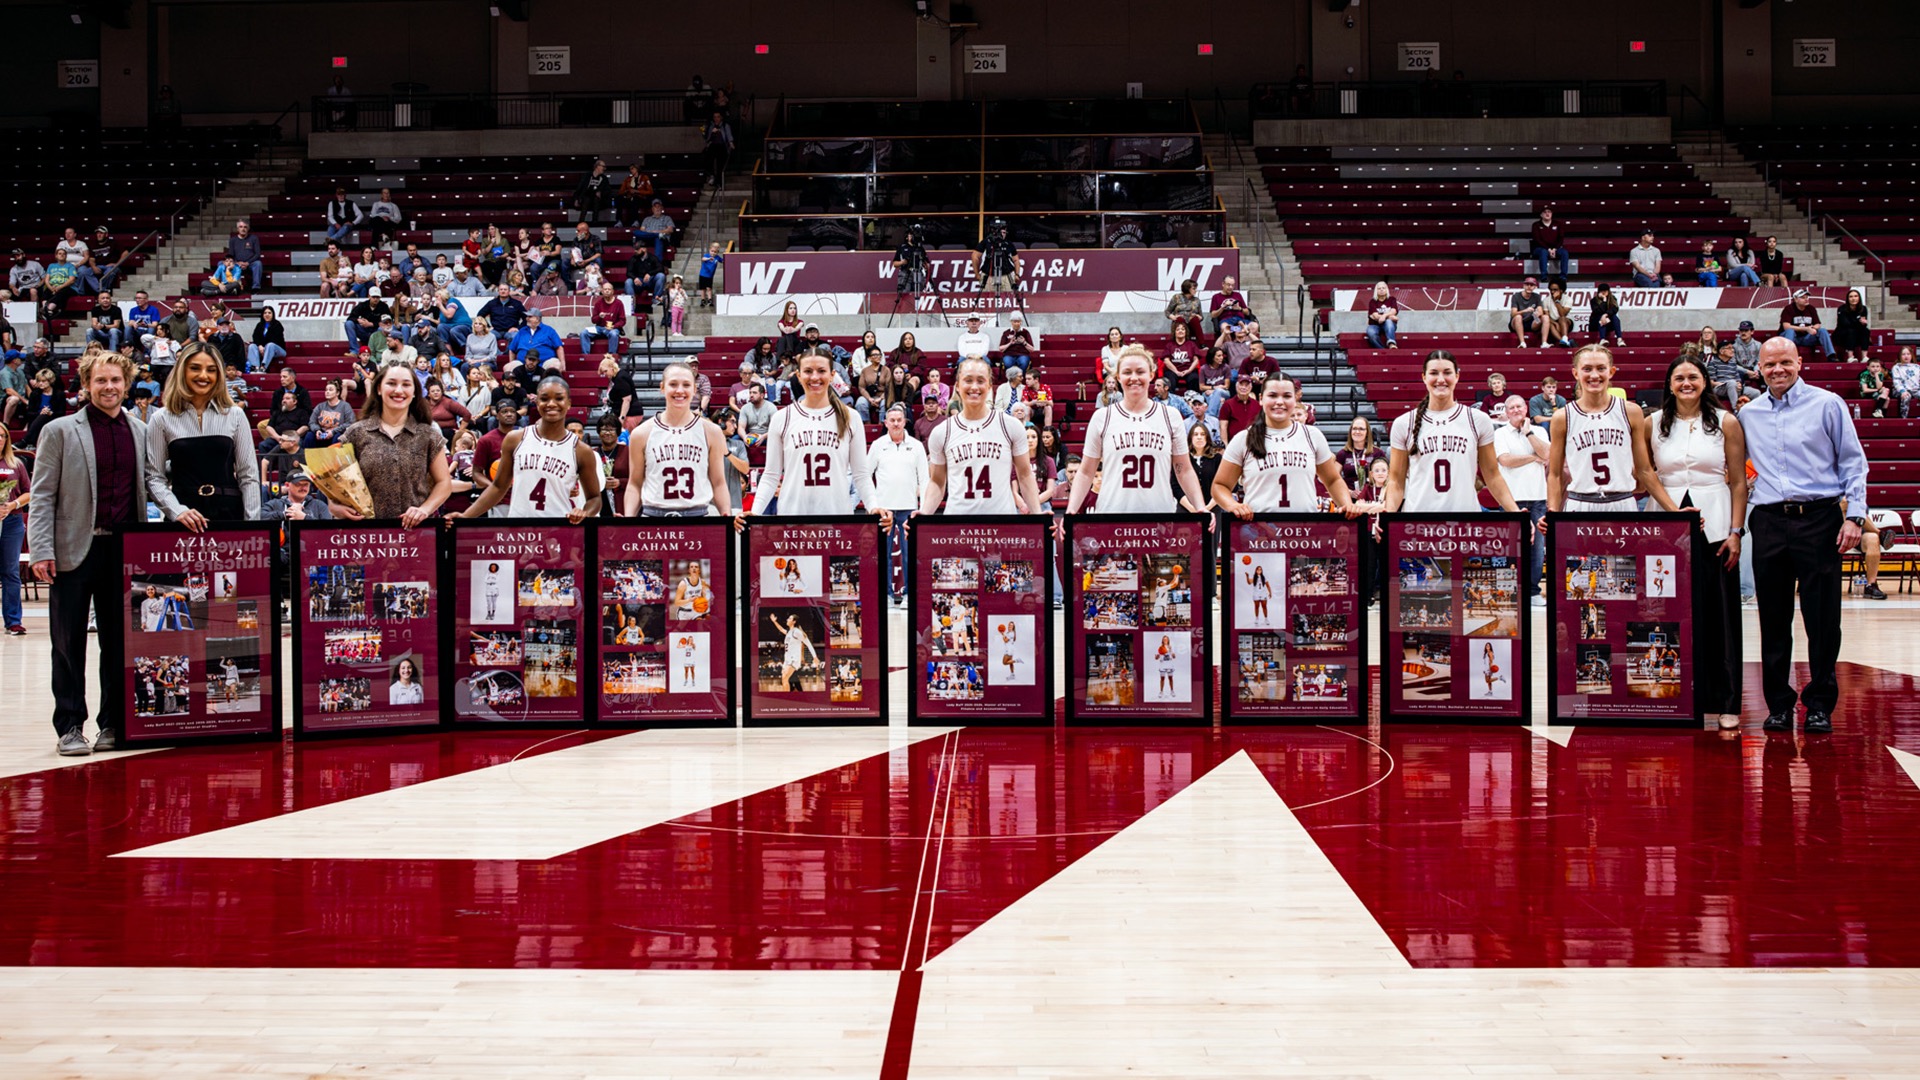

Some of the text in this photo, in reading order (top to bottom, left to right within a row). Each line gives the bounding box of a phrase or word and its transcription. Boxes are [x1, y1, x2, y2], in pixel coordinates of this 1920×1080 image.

[974, 60, 997, 69] 204
[1408, 58, 1430, 67] 203
[1803, 54, 1826, 64] 202
[538, 61, 562, 71] 205
[68, 75, 90, 84] 206
[1031, 258, 1085, 277] A&M
[740, 262, 806, 293] WT
[1158, 258, 1224, 291] WT
[915, 296, 1030, 310] WT BASKETBALL
[1620, 291, 1689, 306] MOTION
[278, 302, 353, 318] TRADITIO
[791, 430, 841, 450] LADY BUFFS
[1112, 432, 1166, 450] LADY BUFFS
[1419, 435, 1468, 456] LADY BUFFS
[1572, 428, 1624, 451] LADY BUFFS
[652, 444, 703, 463] LADY BUFFS
[950, 442, 1002, 463] LADY BUFFS
[519, 454, 570, 478] LADY BUFFS
[1256, 451, 1308, 471] LADY BUFFS
[803, 453, 831, 486] 12
[1122, 455, 1155, 489] 20
[1591, 451, 1611, 486] 5
[964, 465, 992, 499] 14
[1434, 459, 1451, 492] 0
[662, 467, 695, 500] 23
[529, 478, 546, 511] 4
[1278, 474, 1290, 508] 1
[1872, 514, 1885, 522] WT
[496, 532, 542, 542] RANDI
[638, 531, 684, 540] CLAIRE
[784, 530, 842, 539] KENADEE
[1114, 528, 1158, 536] CHLOE
[1275, 528, 1312, 536] ZOEY
[1424, 528, 1482, 538] HOLLIE
[1576, 526, 1661, 536] KYLA KANE
[175, 537, 218, 547] AZIA
[330, 533, 406, 544] GISSELLE
[1090, 540, 1160, 548] CALLAHAN
[1248, 540, 1322, 549] MCBROOM
[476, 545, 544, 554] HARDING
[622, 542, 678, 551] GRAHAM
[773, 541, 830, 550] WINFREY
[1407, 540, 1479, 551] STALDER
[150, 552, 221, 563] HIMEUR
[318, 547, 419, 560] HERNANDEZ
